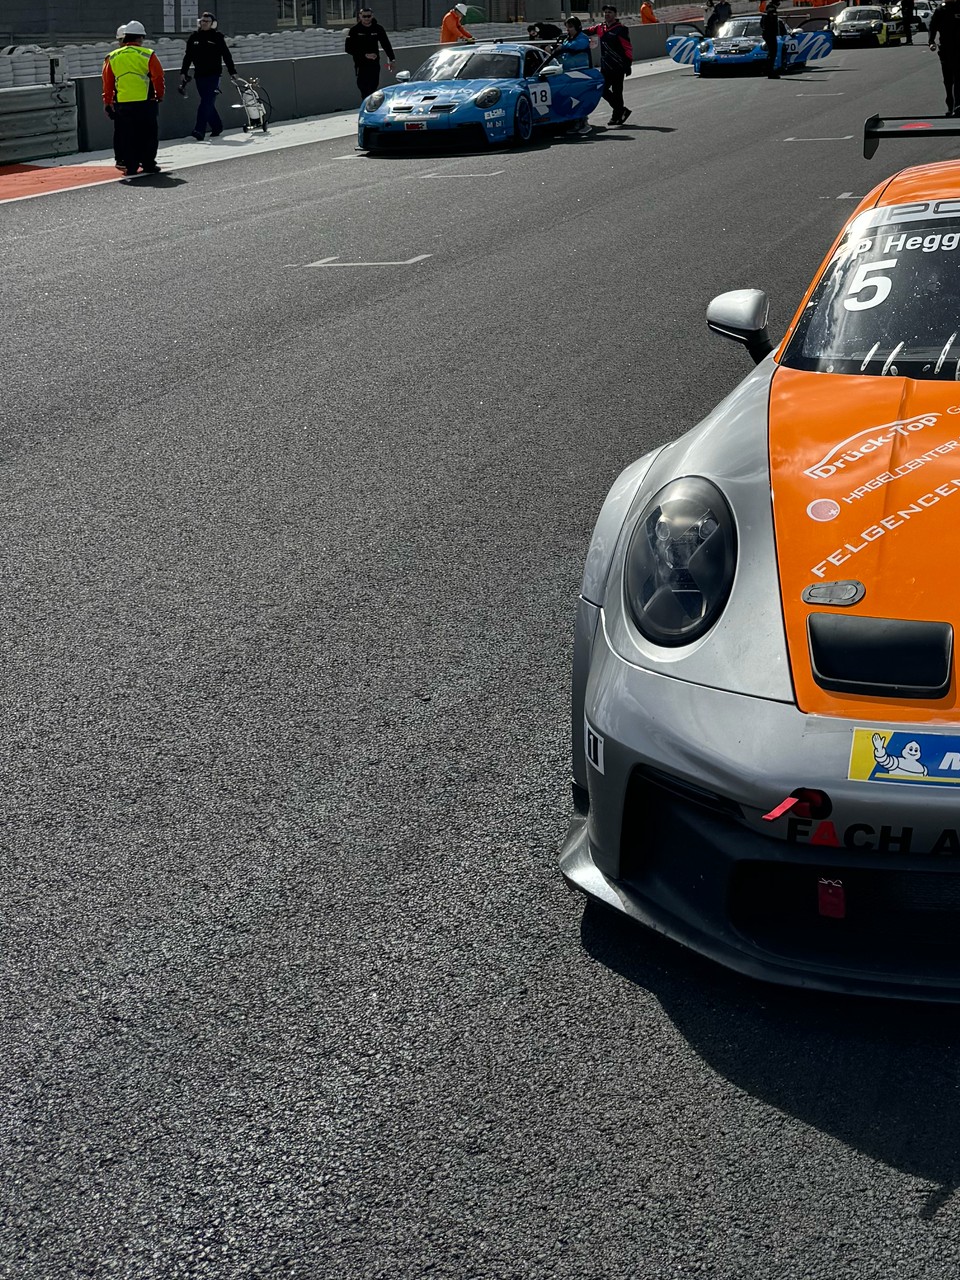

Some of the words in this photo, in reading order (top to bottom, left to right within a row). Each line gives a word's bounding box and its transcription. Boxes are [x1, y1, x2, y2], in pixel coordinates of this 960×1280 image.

[532, 89, 548, 104] 18
[843, 258, 898, 312] 5
[814, 415, 938, 479] Drück-Top
